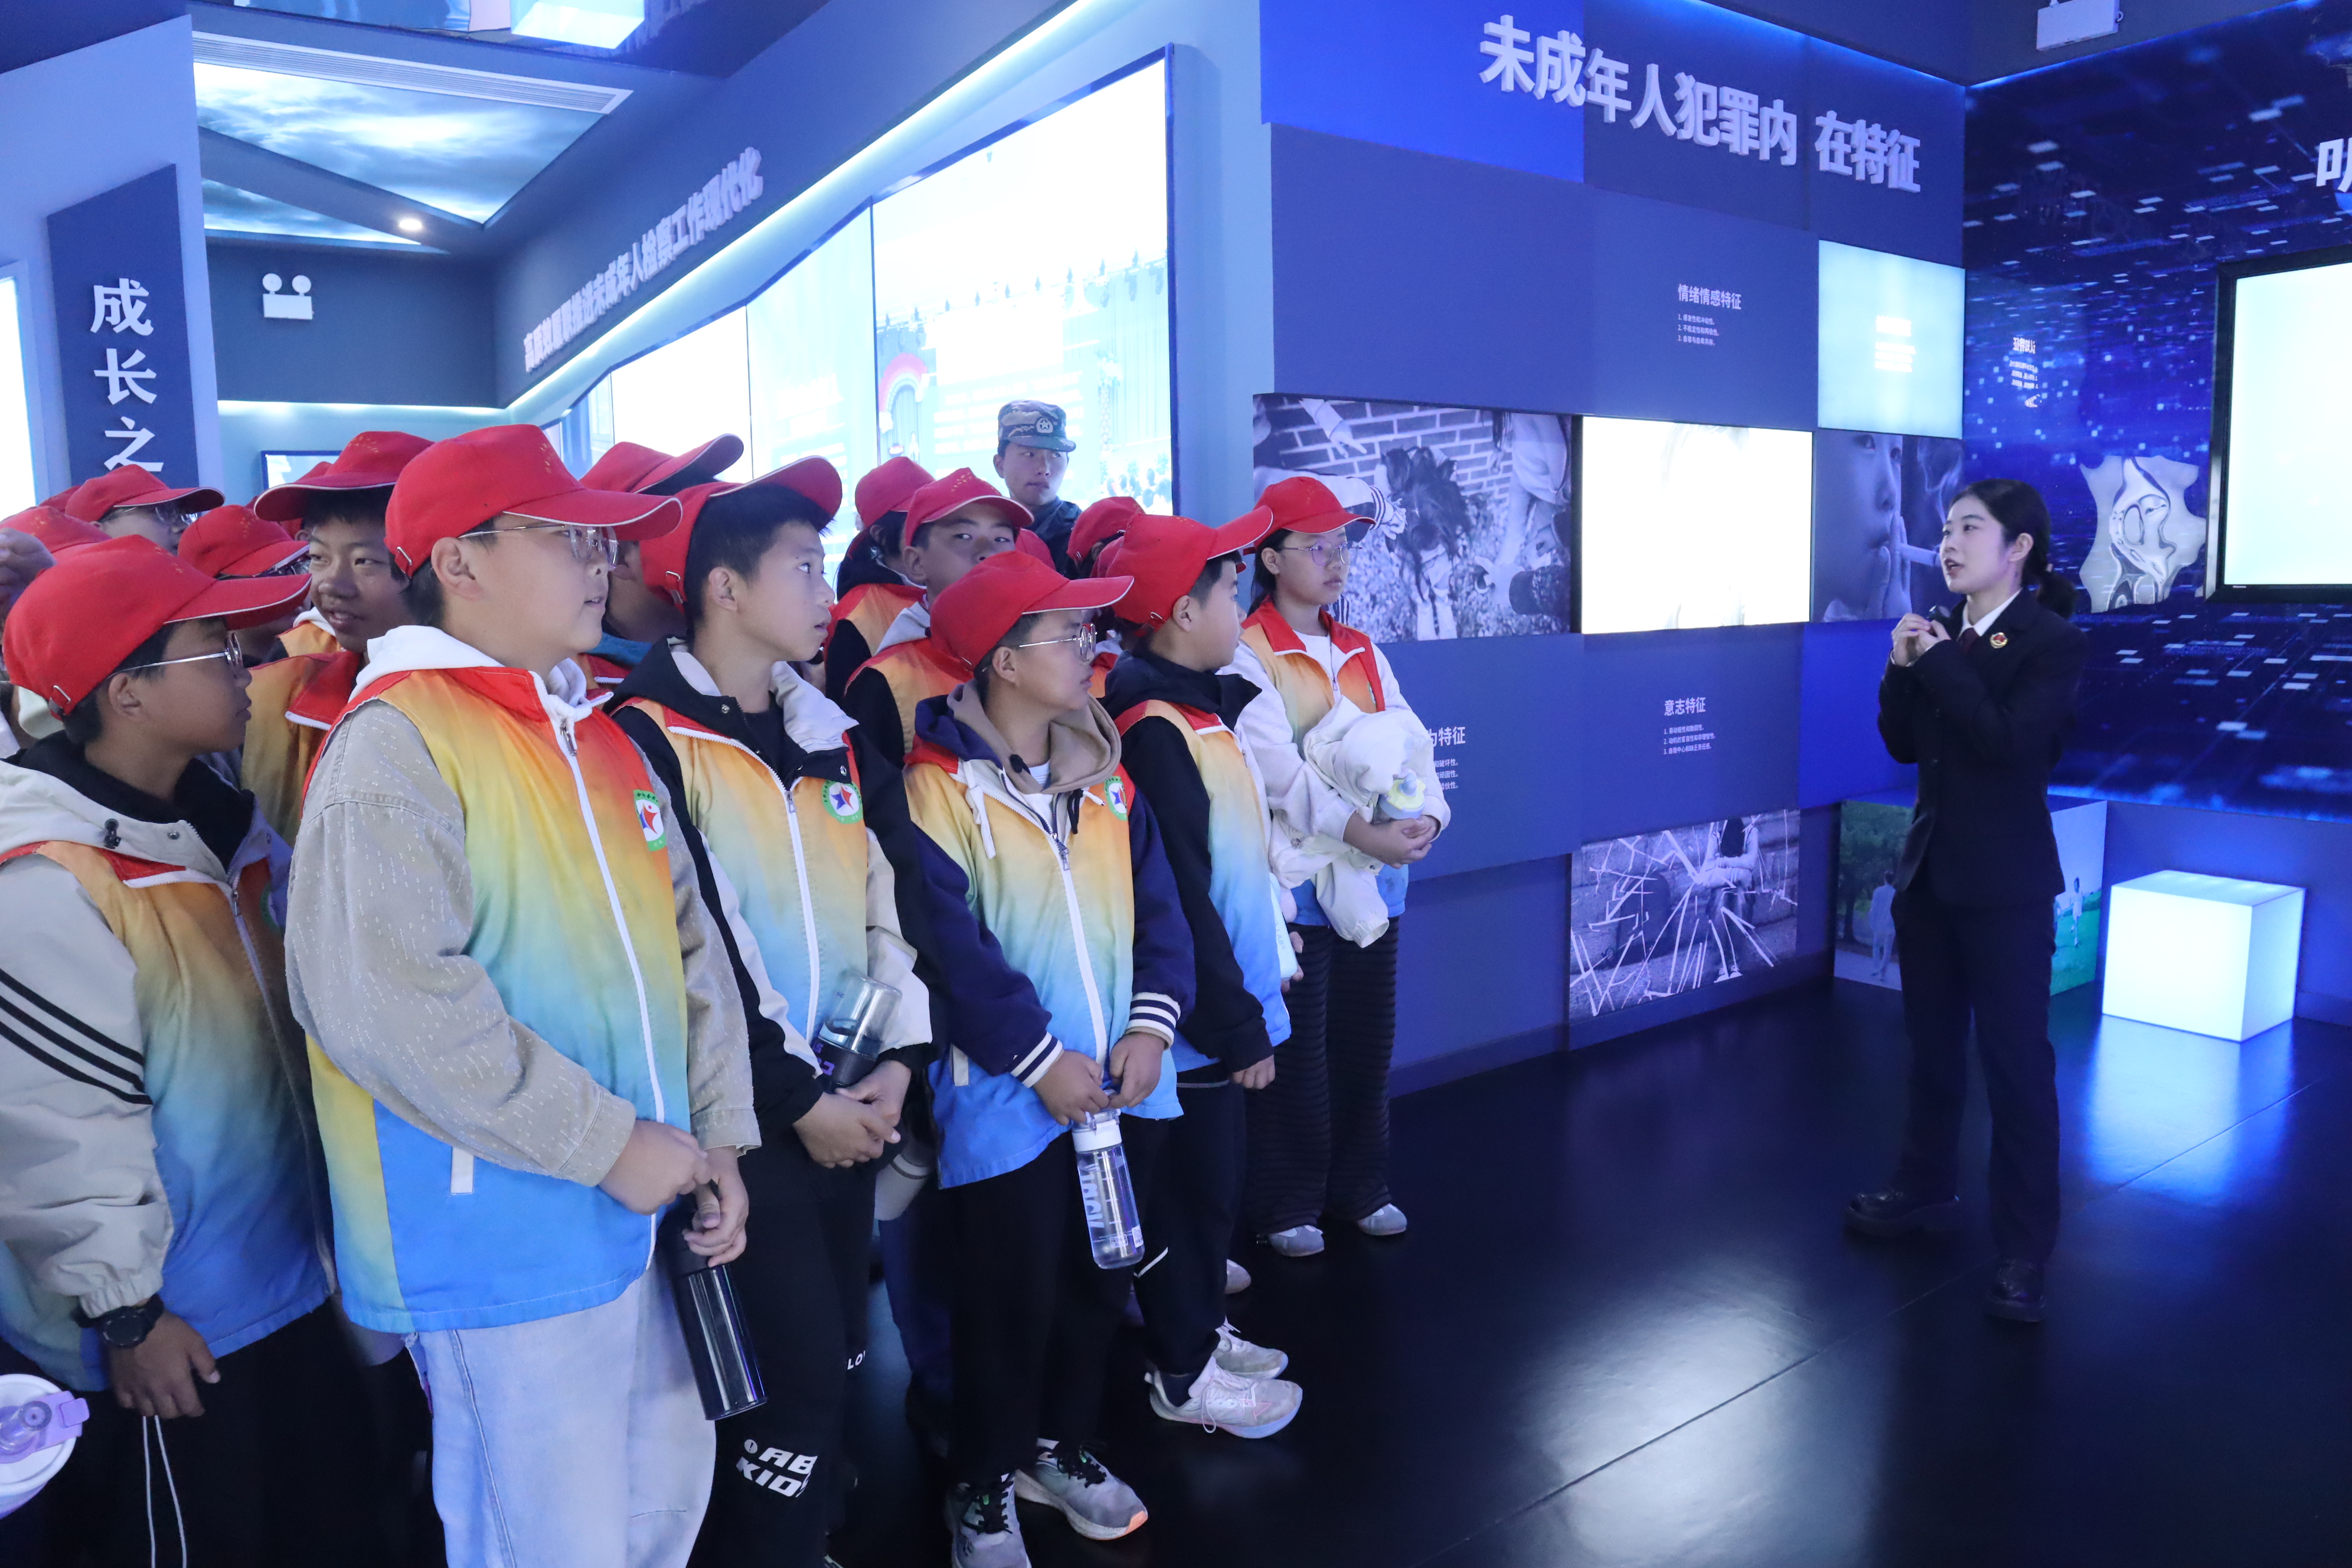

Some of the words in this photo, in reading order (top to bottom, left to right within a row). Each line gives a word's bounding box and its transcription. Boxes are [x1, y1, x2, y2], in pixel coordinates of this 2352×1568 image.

[1678, 283, 1741, 309] 情绪情感特征
[1664, 697, 1706, 716] 意志特征
